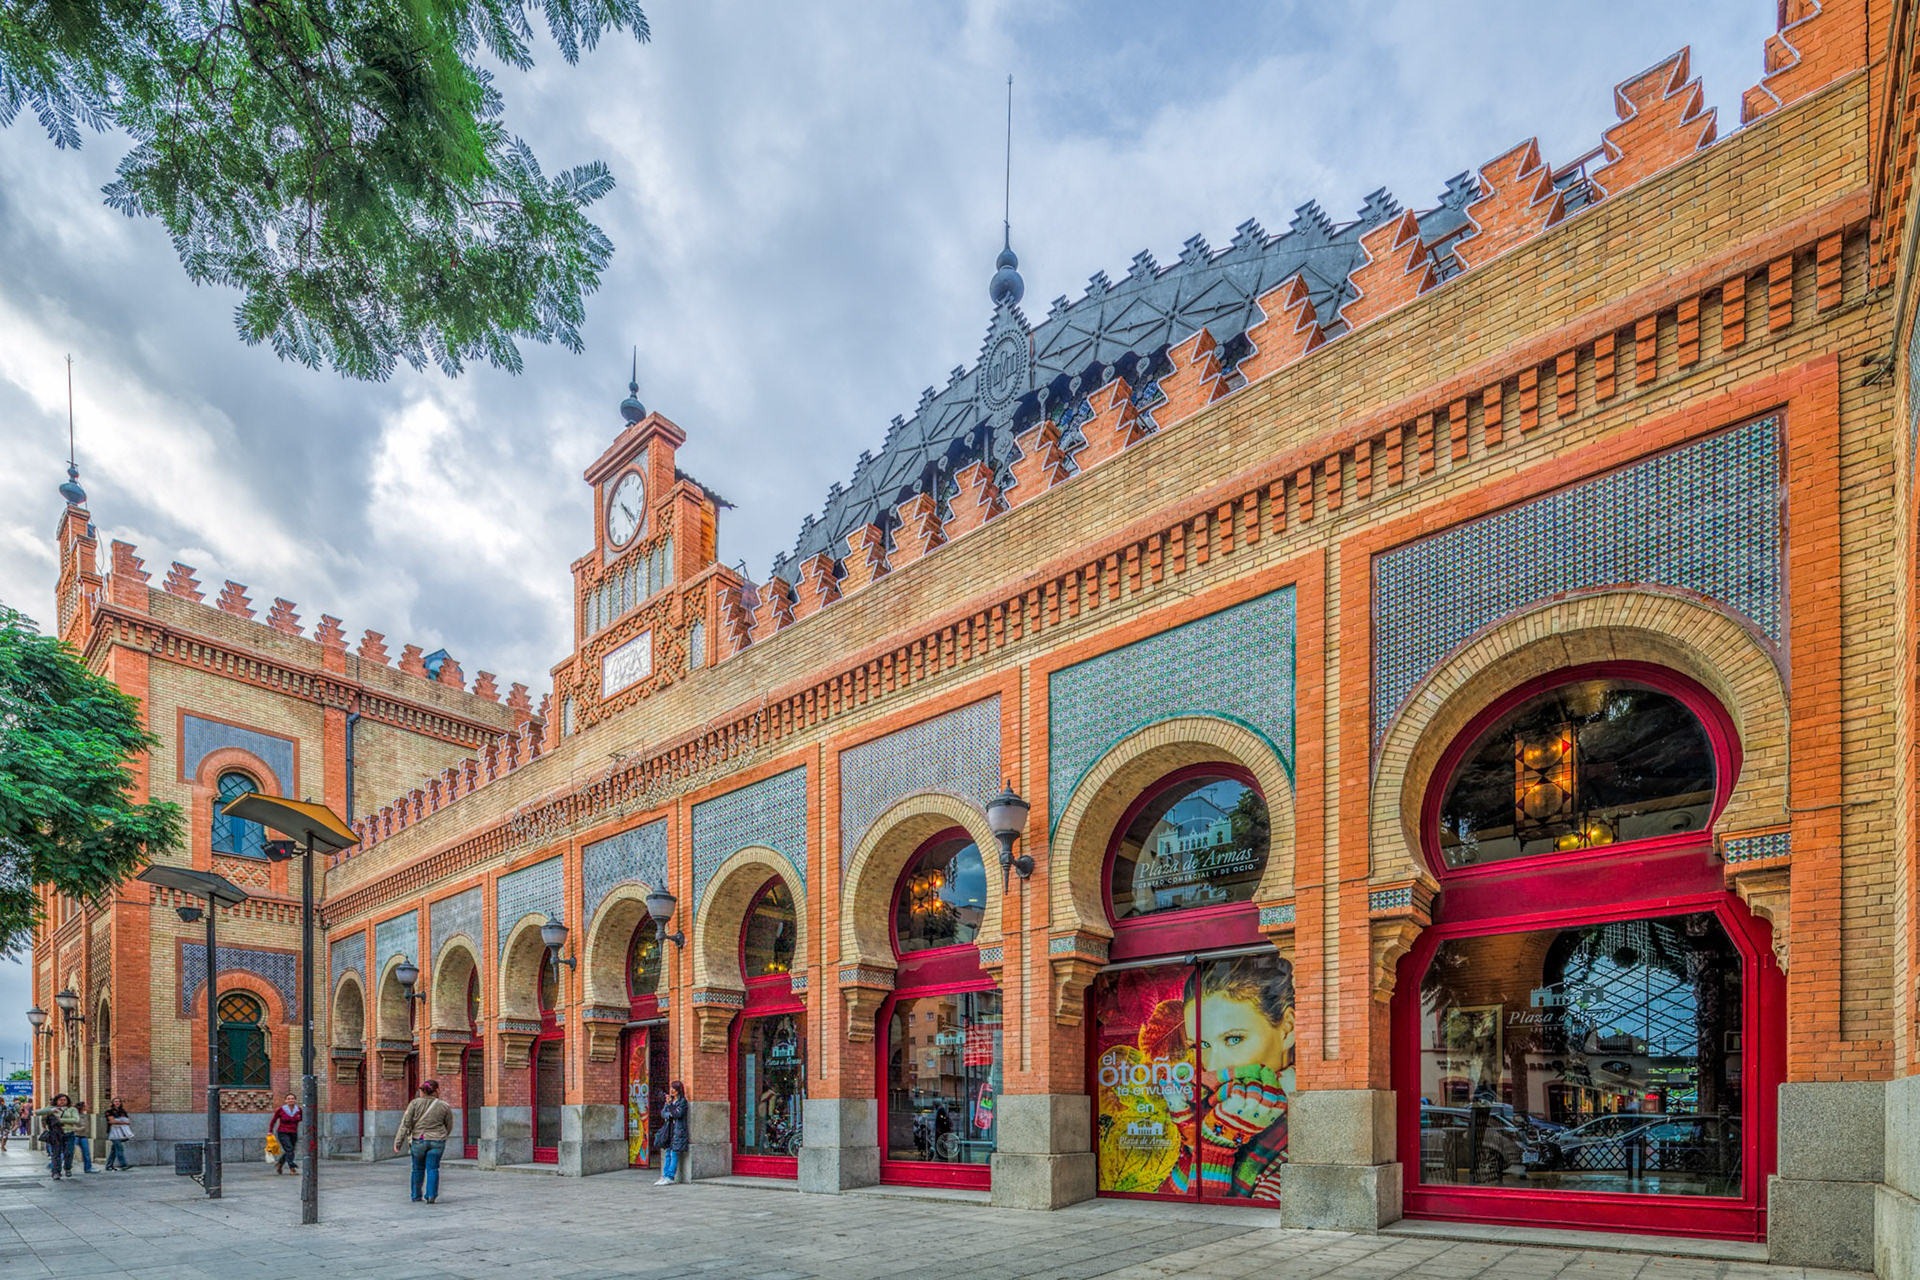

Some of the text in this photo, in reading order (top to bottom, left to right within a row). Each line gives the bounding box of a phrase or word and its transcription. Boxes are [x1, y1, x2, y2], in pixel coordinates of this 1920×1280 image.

[1140, 848, 1253, 879] Plaza de Armas
[1138, 880, 1164, 888] CENTRO
[1167, 871, 1210, 884] COMERCIAL
[1220, 867, 1230, 875] DE
[1232, 863, 1254, 873] OCIO
[1508, 1011, 1554, 1025] Plaza
[1102, 1051, 1116, 1066] el
[1098, 1055, 1194, 1086] otoño
[1117, 1083, 1192, 1096] te envuelve
[1137, 1103, 1155, 1113] en
